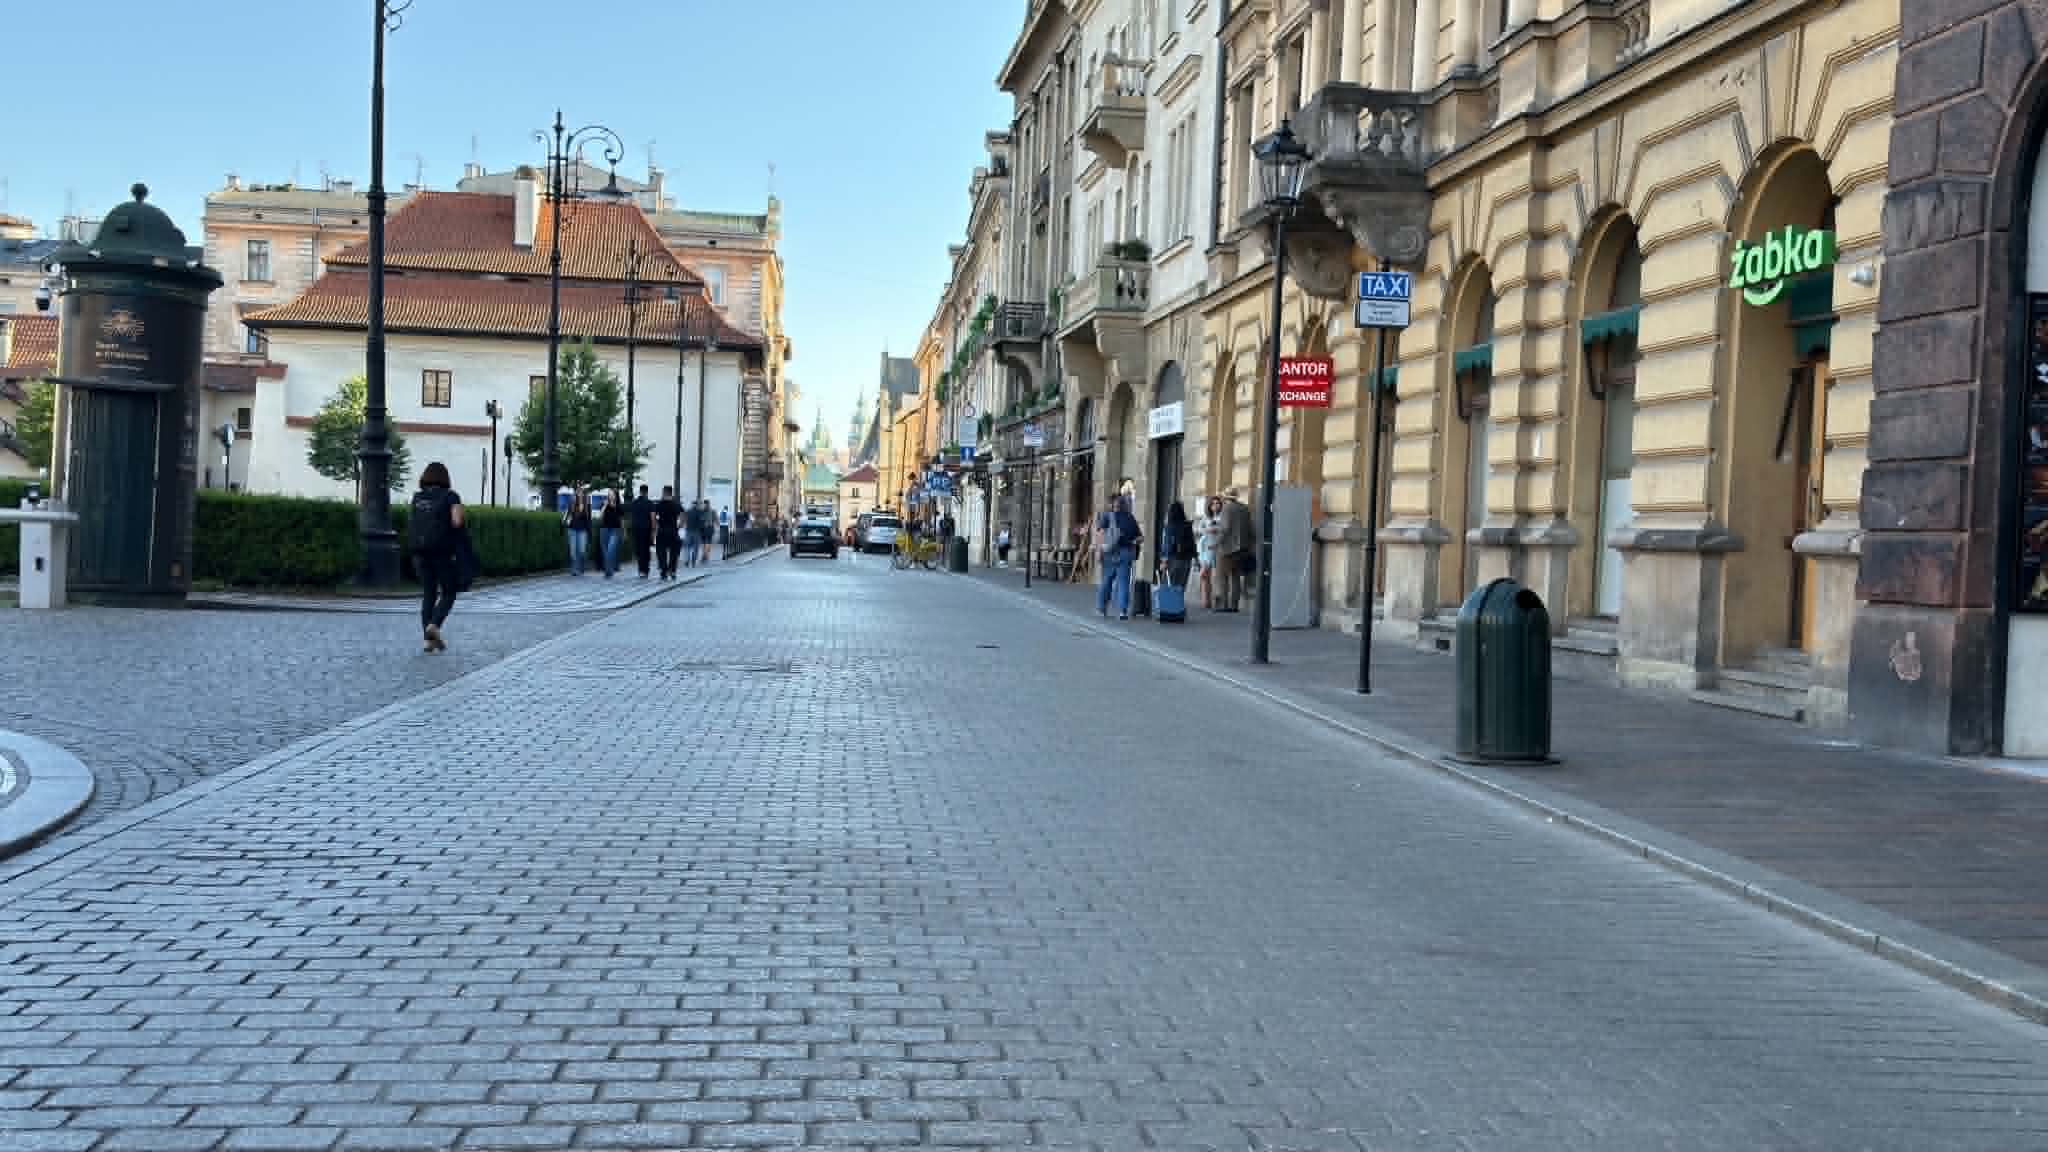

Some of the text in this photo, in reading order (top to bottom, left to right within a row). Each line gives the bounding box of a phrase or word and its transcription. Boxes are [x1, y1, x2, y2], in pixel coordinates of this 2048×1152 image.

[1729, 225, 1823, 289] żabka
[1362, 275, 1408, 297] TAXI
[1279, 391, 1327, 401] XCHANGE
